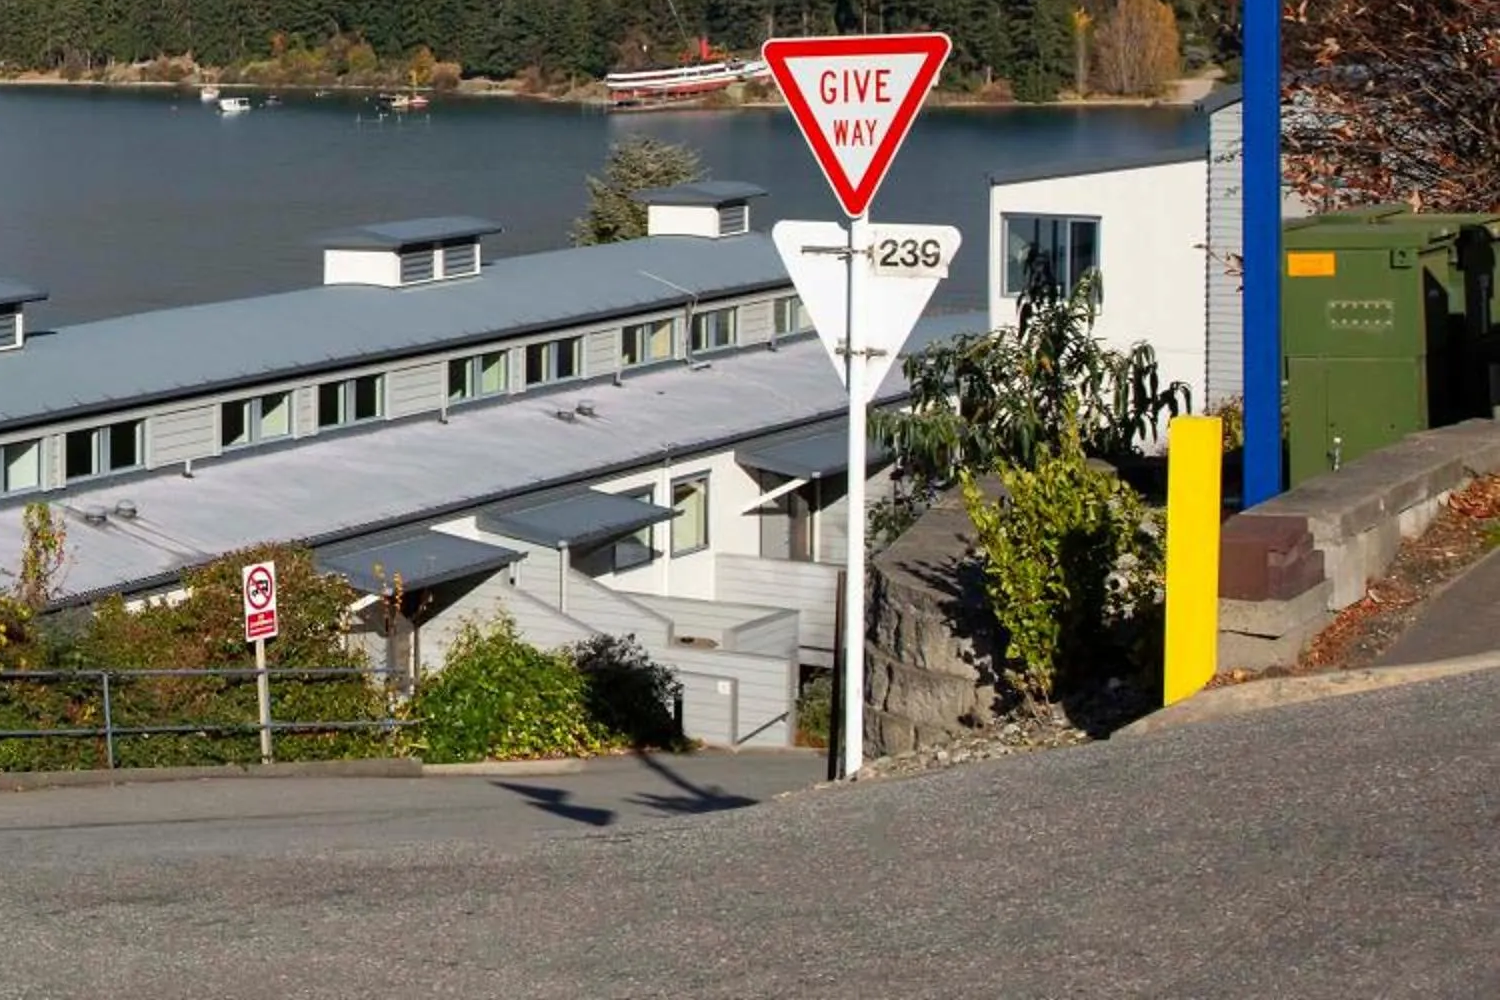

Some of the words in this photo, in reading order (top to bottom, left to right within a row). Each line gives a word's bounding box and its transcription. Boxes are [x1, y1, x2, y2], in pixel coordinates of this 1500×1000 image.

[819, 69, 892, 105] GIVE
[833, 119, 877, 147] WAY
[879, 239, 942, 268] 239
